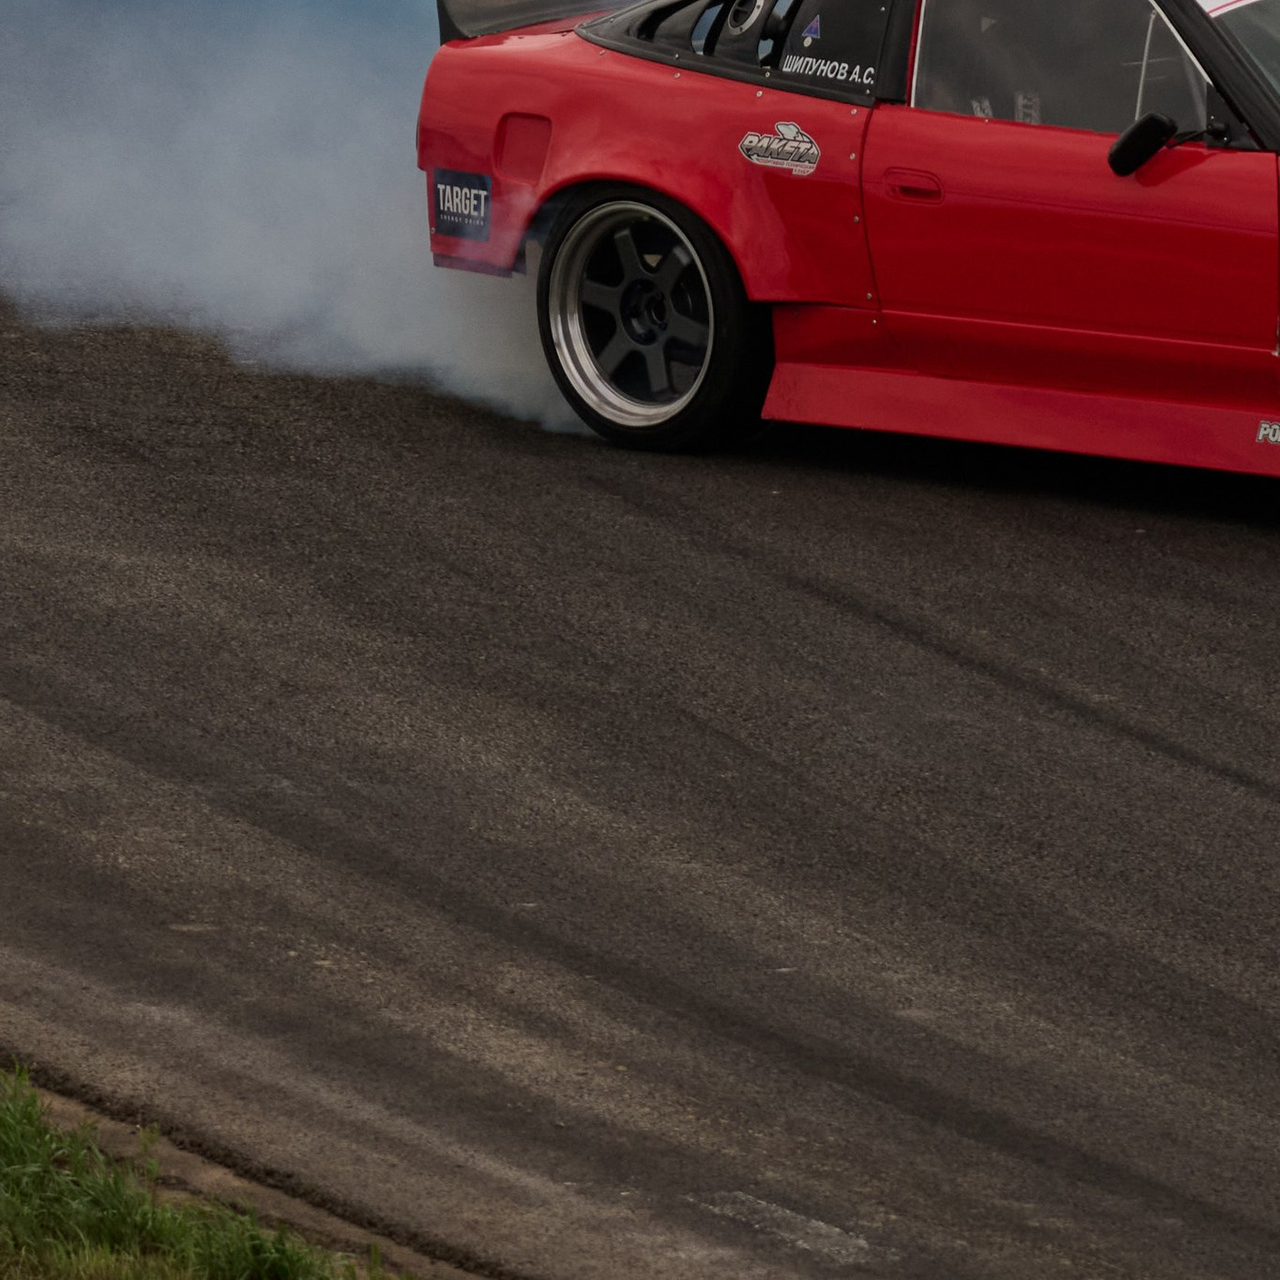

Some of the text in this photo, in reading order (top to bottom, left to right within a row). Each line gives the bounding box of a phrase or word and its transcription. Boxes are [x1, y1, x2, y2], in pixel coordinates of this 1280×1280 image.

[782, 54, 849, 80] ШИПУНОВ
[740, 133, 819, 164] РАКЕТА
[437, 183, 488, 217] TARGET
